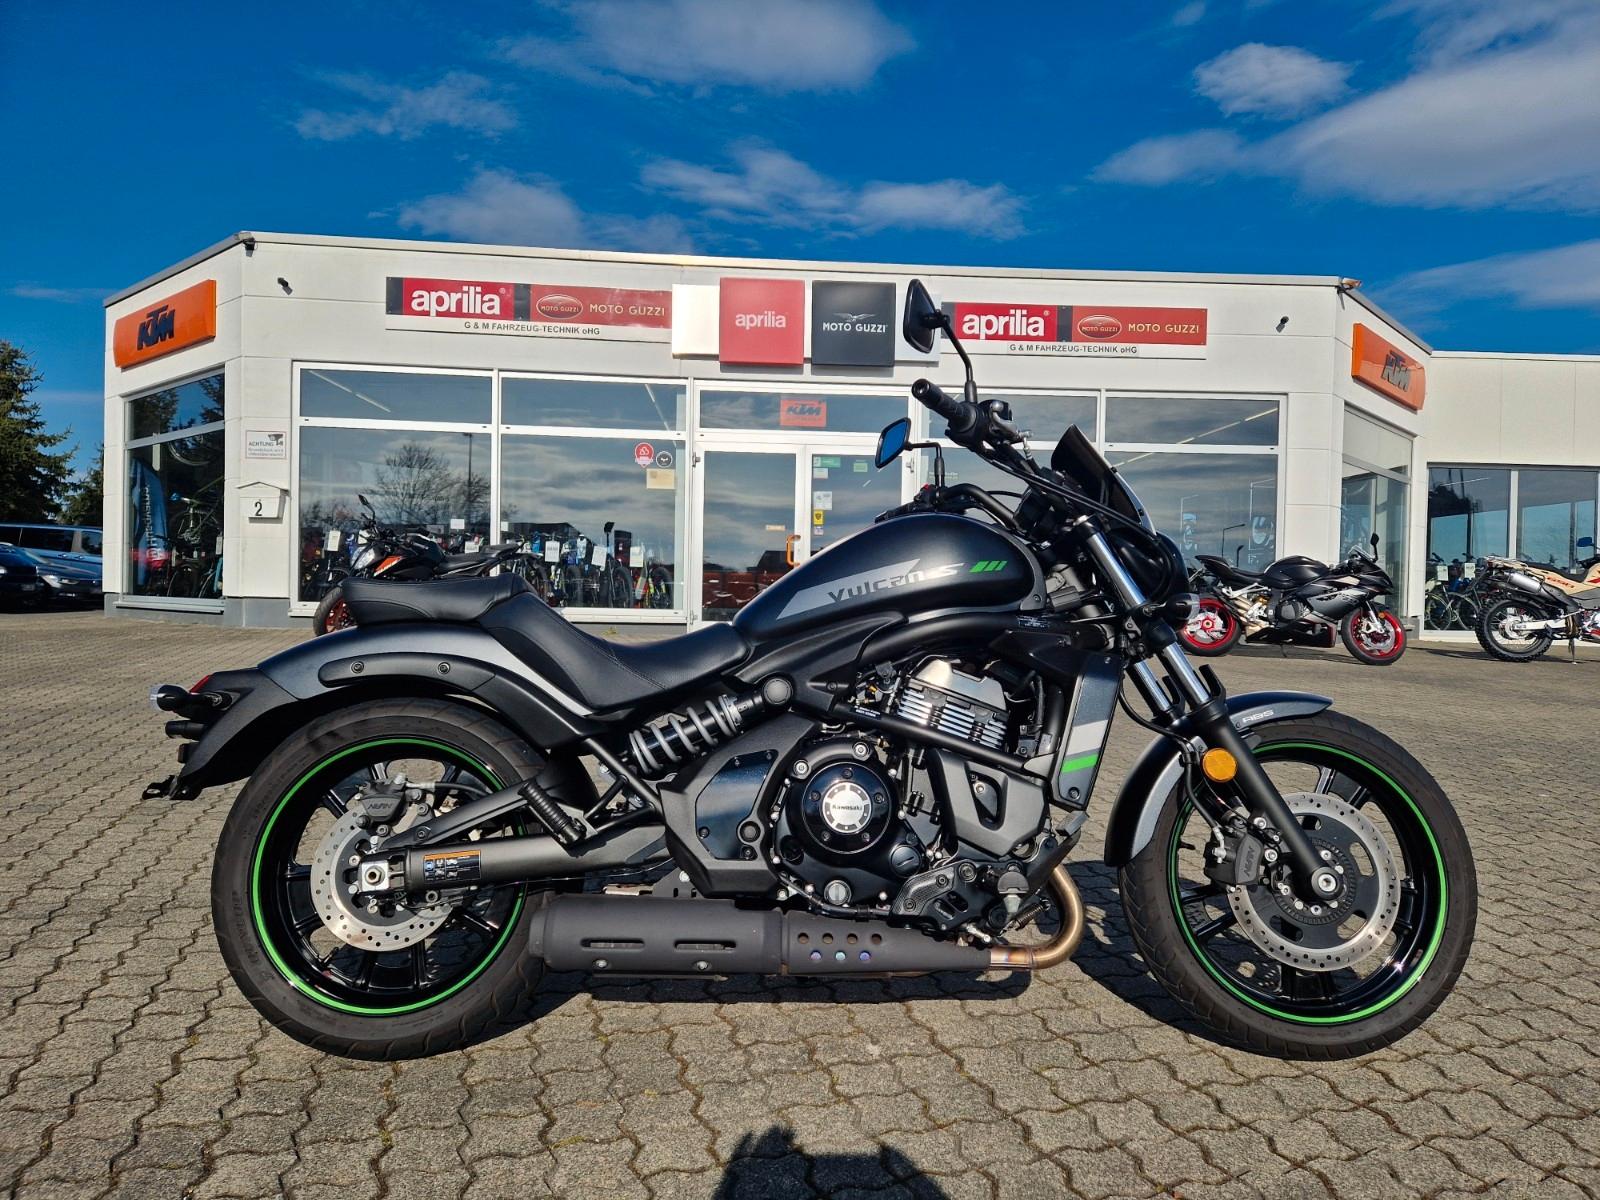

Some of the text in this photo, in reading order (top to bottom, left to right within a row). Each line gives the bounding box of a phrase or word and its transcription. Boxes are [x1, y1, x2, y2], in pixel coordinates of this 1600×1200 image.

[411, 285, 500, 317] aprilia
[589, 303, 665, 317] MOTO GUZZI
[735, 310, 786, 330] aprilia
[822, 321, 886, 333] MOTO GUZZI
[962, 309, 1045, 340] aprilia
[137, 304, 175, 351] KTM
[464, 321, 472, 329] G
[482, 322, 490, 330] M
[492, 322, 580, 334] FAHRZEUG-TECHNIK
[582, 327, 600, 335] oHG
[1128, 323, 1199, 334] MOTO GUZZI
[1035, 344, 1118, 353] FAHRZEUG-TECHNIK
[1120, 346, 1137, 354] oHG
[1381, 349, 1412, 393] KTM
[786, 404, 822, 416] KTM
[254, 501, 263, 516] 2
[827, 570, 925, 602] Vulcan
[1242, 709, 1274, 723] ABS
